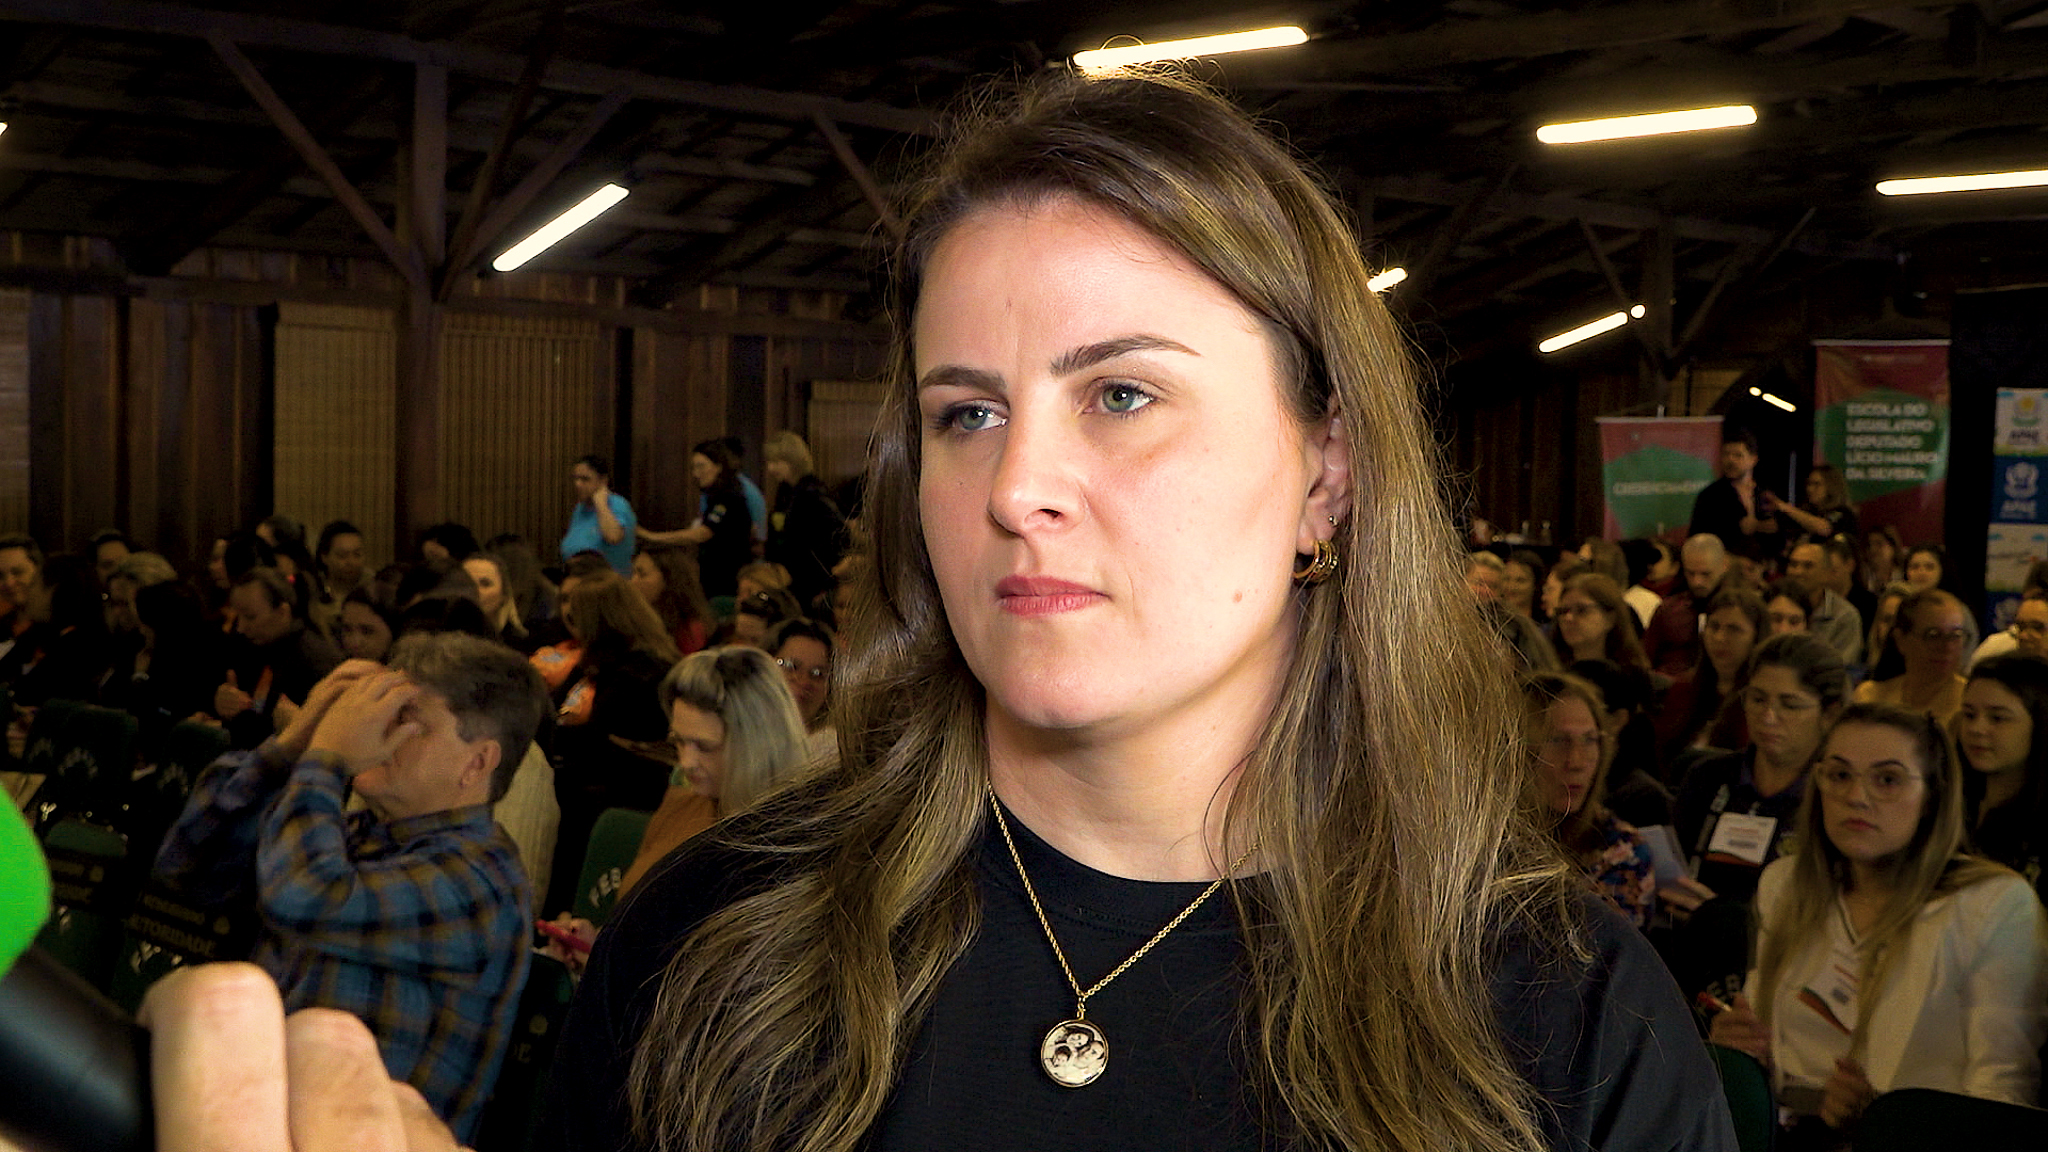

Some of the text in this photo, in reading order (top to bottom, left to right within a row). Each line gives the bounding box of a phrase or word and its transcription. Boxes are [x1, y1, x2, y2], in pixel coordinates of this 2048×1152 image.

[1846, 403, 1929, 416] ESCOLA DO
[1846, 419, 1936, 432] LEGISLATIVO
[1846, 435, 1923, 448] DEPUTADO
